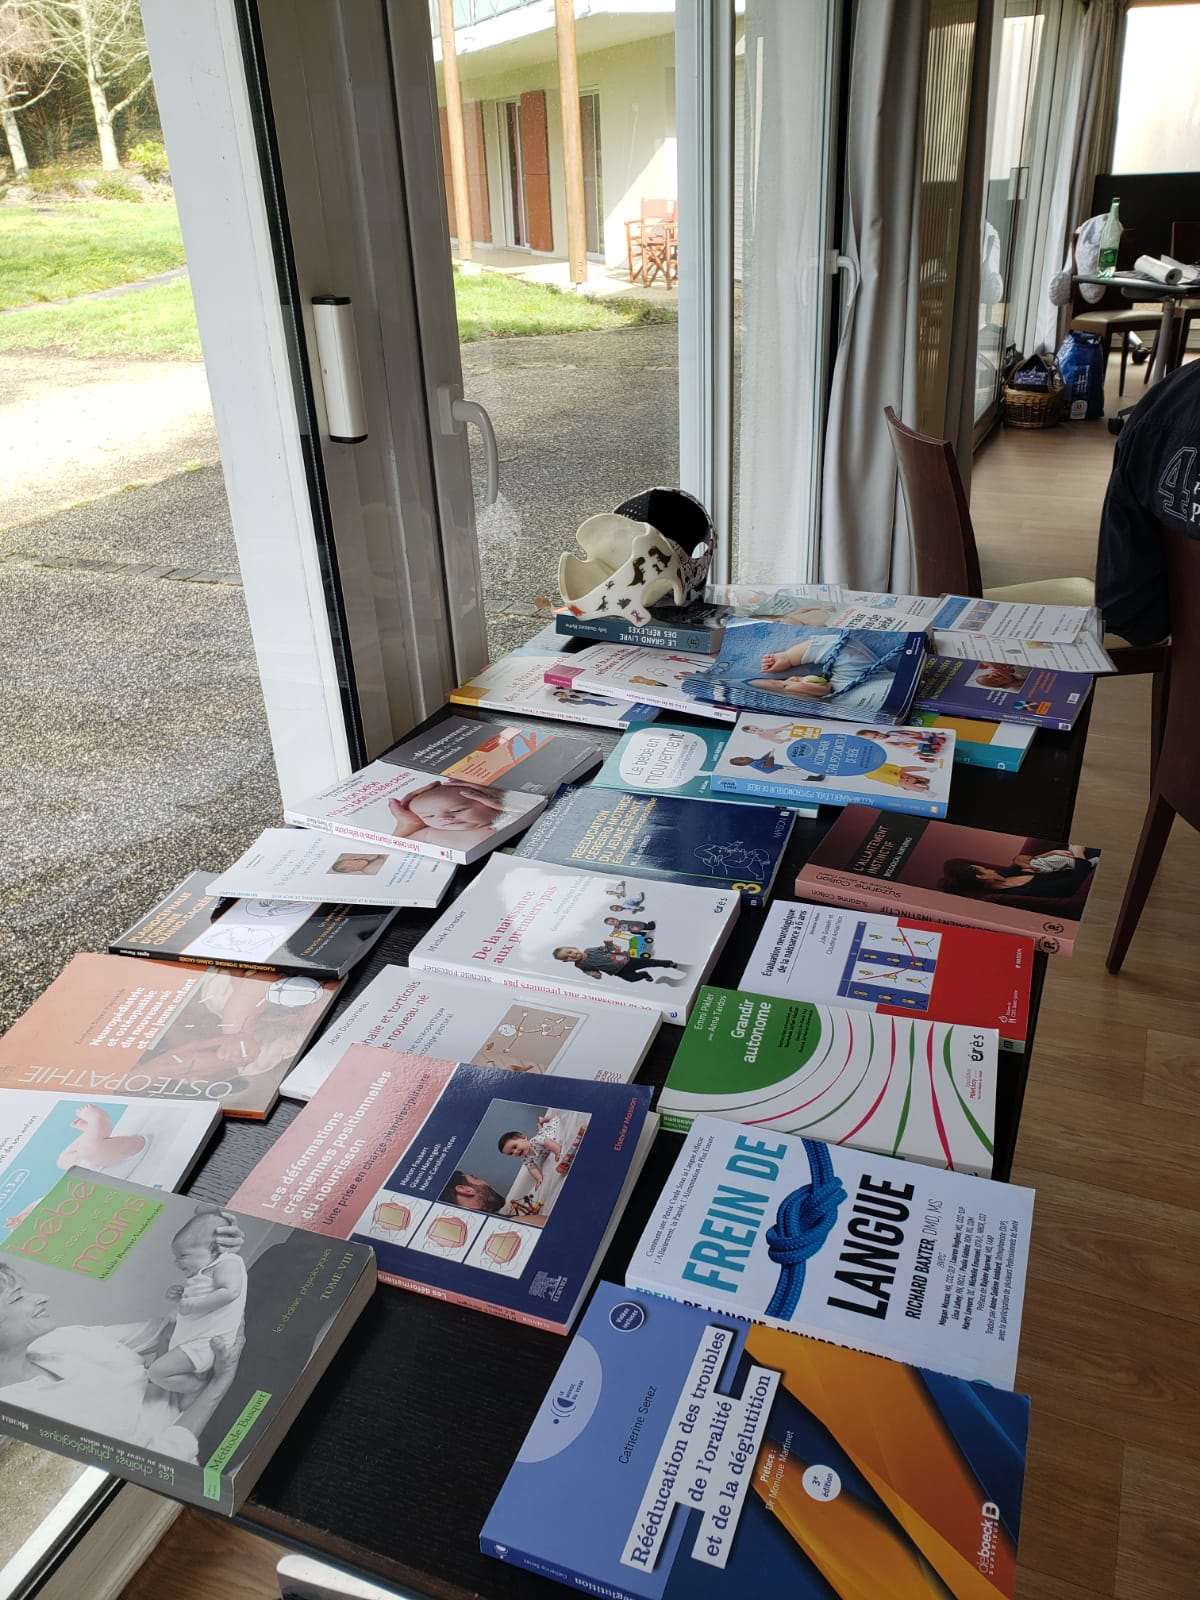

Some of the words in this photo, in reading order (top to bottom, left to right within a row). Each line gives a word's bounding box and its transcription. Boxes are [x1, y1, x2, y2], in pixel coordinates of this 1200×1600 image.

[620, 634, 641, 642] LIVRE
[641, 636, 665, 646] GRAND
[472, 940, 493, 961] De
[488, 933, 501, 945] la
[495, 890, 536, 934] naissance
[492, 944, 513, 964] aux
[508, 902, 546, 945] premiers
[799, 910, 808, 921] ans
[761, 946, 782, 977] Évaluation
[776, 908, 796, 947] neurologique
[784, 931, 800, 959] naissance
[777, 965, 787, 974] de
[782, 958, 790, 966] la
[136, 1037, 148, 1050] et
[145, 1025, 158, 1040] du
[155, 1002, 176, 1028] jeune
[173, 978, 196, 1005] enfant
[381, 1012, 394, 1024] et
[388, 980, 421, 1012] torticolis
[694, 1014, 707, 1030] Emmi
[702, 992, 714, 1015] Pikler
[708, 1015, 719, 1032] Anna
[714, 995, 726, 1016] Tardos
[730, 999, 754, 1038] Grandir
[108, 1038, 117, 1049] et
[122, 1036, 133, 1050] du
[744, 1002, 772, 1064] autonome
[969, 1034, 984, 1062] érès
[17, 1065, 234, 1098] OSTÉOPATHIE
[624, 1097, 639, 1126] Masson
[262, 1185, 287, 1210] Les
[281, 1110, 346, 1188] déformations
[283, 1146, 337, 1216] crâniennes
[333, 1070, 392, 1149] positionnelles
[302, 1202, 320, 1222] du
[315, 1137, 366, 1200] nourrisson
[322, 1206, 342, 1227] Une
[338, 1184, 358, 1209] prise
[355, 1170, 368, 1184] en
[363, 1142, 388, 1172] charge
[682, 1184, 770, 1293] FREIN
[726, 1134, 788, 1182] DE
[826, 1174, 915, 1320] LANGUE
[321, 1270, 341, 1301] TOME
[432, 1292, 447, 1300] Les
[906, 1274, 929, 1320] RICHARD
[207, 1425, 244, 1471] Méthode
[236, 1390, 269, 1429] Busquet
[618, 1415, 646, 1465] Catherine
[638, 1385, 658, 1414] Senez
[696, 1400, 732, 1471] l'oralité
[730, 1374, 772, 1476] déglutition
[40, 1429, 112, 1468] physiologiques
[630, 1440, 687, 1566] Rééducation
[682, 1404, 700, 1434] des
[691, 1330, 727, 1402] troubles
[768, 1464, 786, 1498] Monique
[779, 1430, 795, 1464] Martinet
[115, 1454, 154, 1481] chaînes
[155, 1469, 176, 1487] Les
[760, 1453, 776, 1483] Préface
[822, 1472, 834, 1498] édition
[688, 1474, 708, 1502] de
[720, 1480, 740, 1500] la
[712, 1502, 732, 1532] de
[706, 1537, 723, 1557] et
